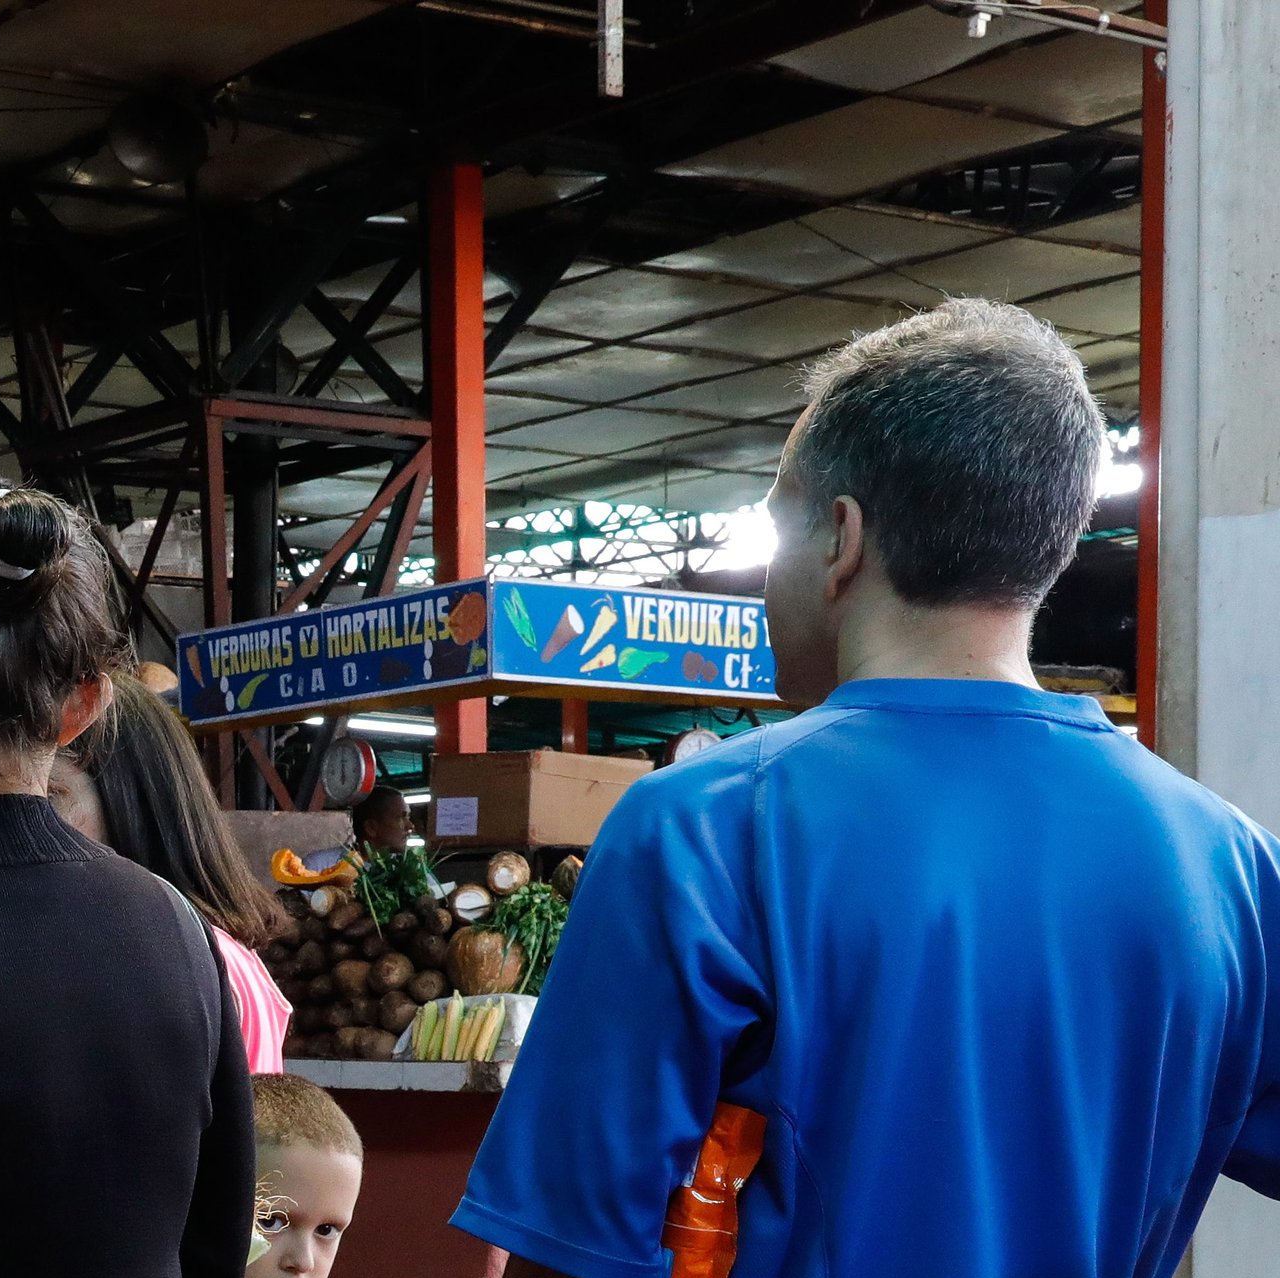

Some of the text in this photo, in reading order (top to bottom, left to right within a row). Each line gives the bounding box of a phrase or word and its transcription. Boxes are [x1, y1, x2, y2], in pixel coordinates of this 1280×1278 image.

[208, 595, 453, 678] VERDURAS Y HORTALIZAS
[622, 595, 759, 649] VERDURAS
